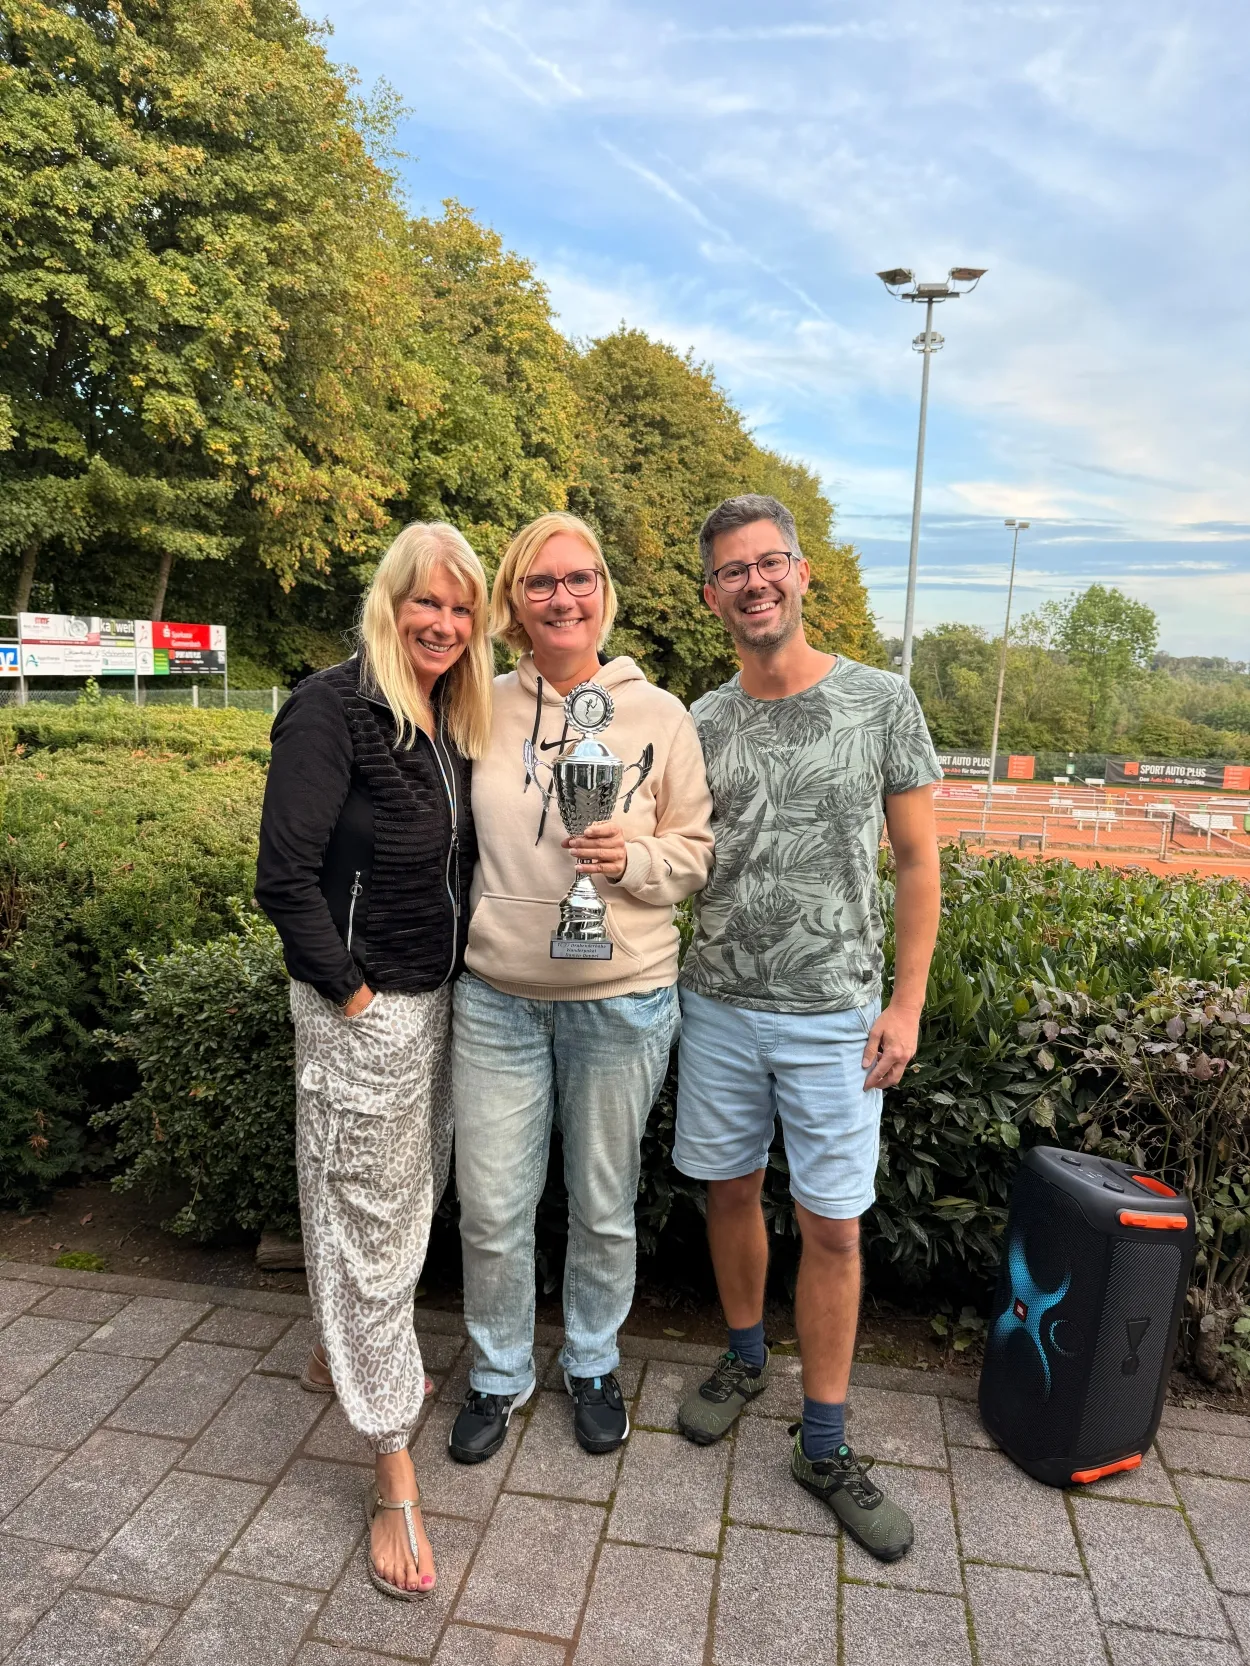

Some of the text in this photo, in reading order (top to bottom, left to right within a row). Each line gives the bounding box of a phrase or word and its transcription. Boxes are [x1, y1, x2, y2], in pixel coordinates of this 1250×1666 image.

[937, 755, 991, 767] ORT AUTO PLUS
[1140, 764, 1207, 778] SPORT AUTO PLUS
